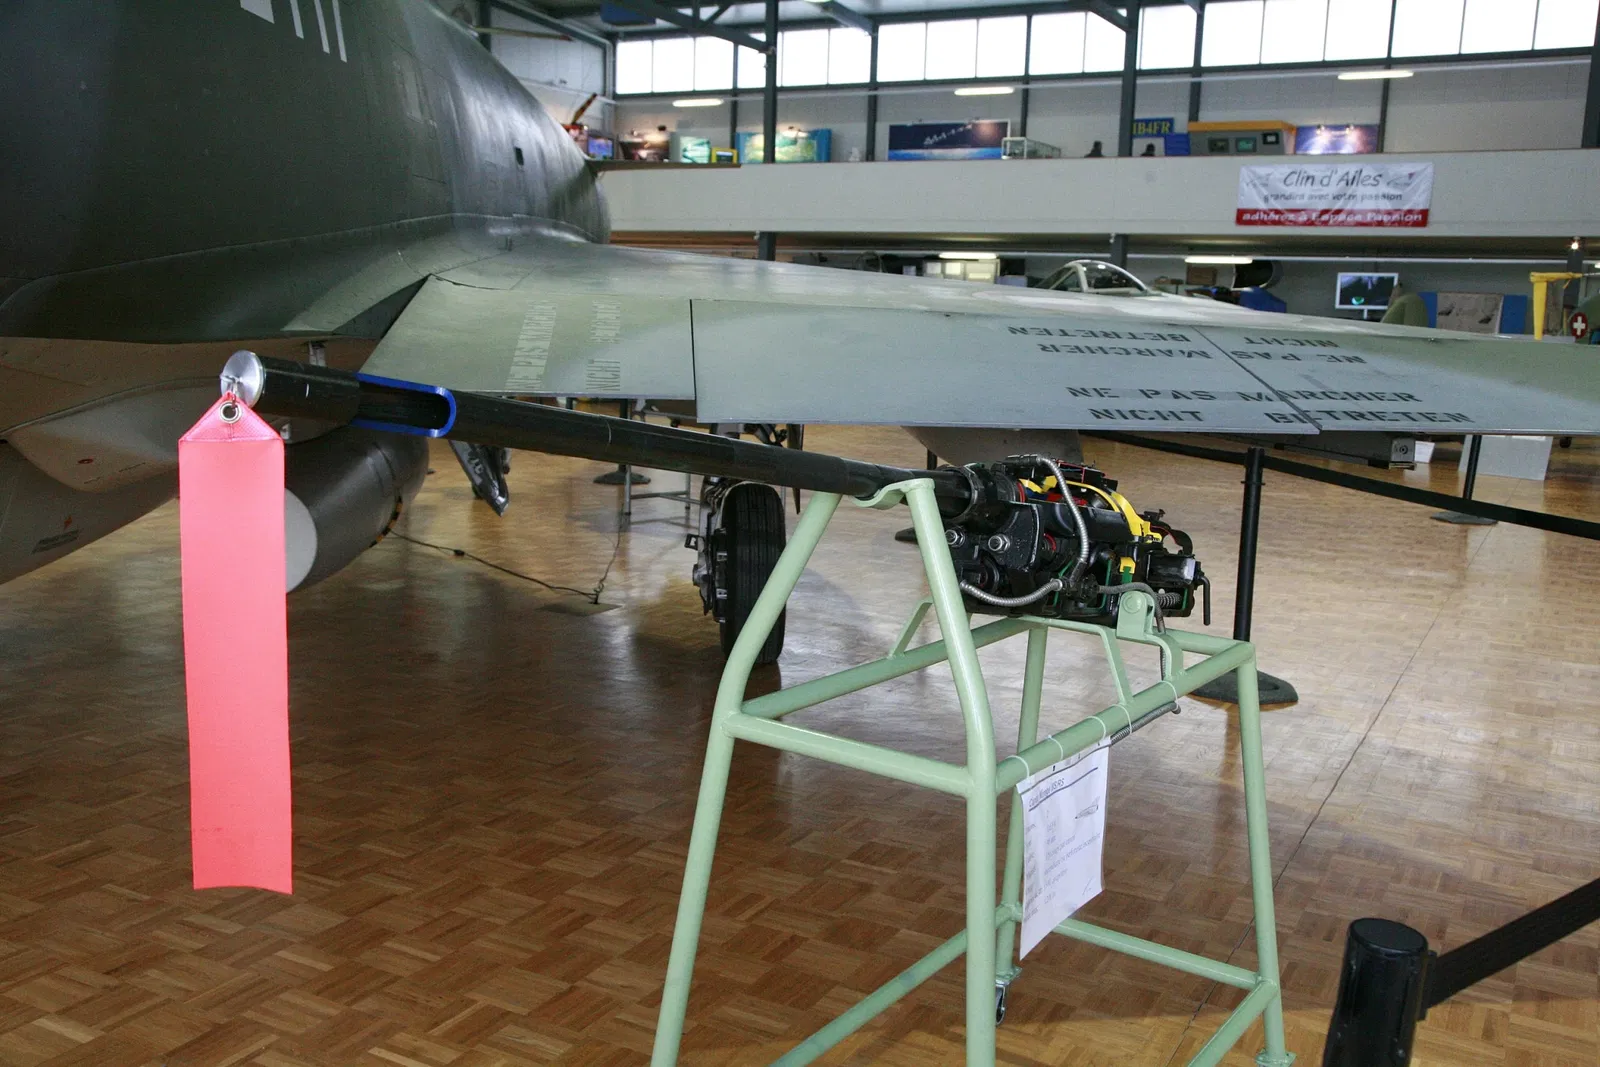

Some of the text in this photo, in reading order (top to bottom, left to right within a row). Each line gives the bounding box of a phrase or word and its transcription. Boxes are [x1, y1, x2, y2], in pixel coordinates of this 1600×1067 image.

[1283, 168, 1383, 187] Clin d'Ailes
[1008, 327, 1191, 342] BETRETEN
[1038, 344, 1213, 359] MARCHER
[1230, 351, 1301, 361] PAS
[585, 359, 620, 391] NICHT
[1066, 386, 1422, 402] NE PAS MARCHER
[1088, 408, 1475, 424] NICHT BETRETEN
